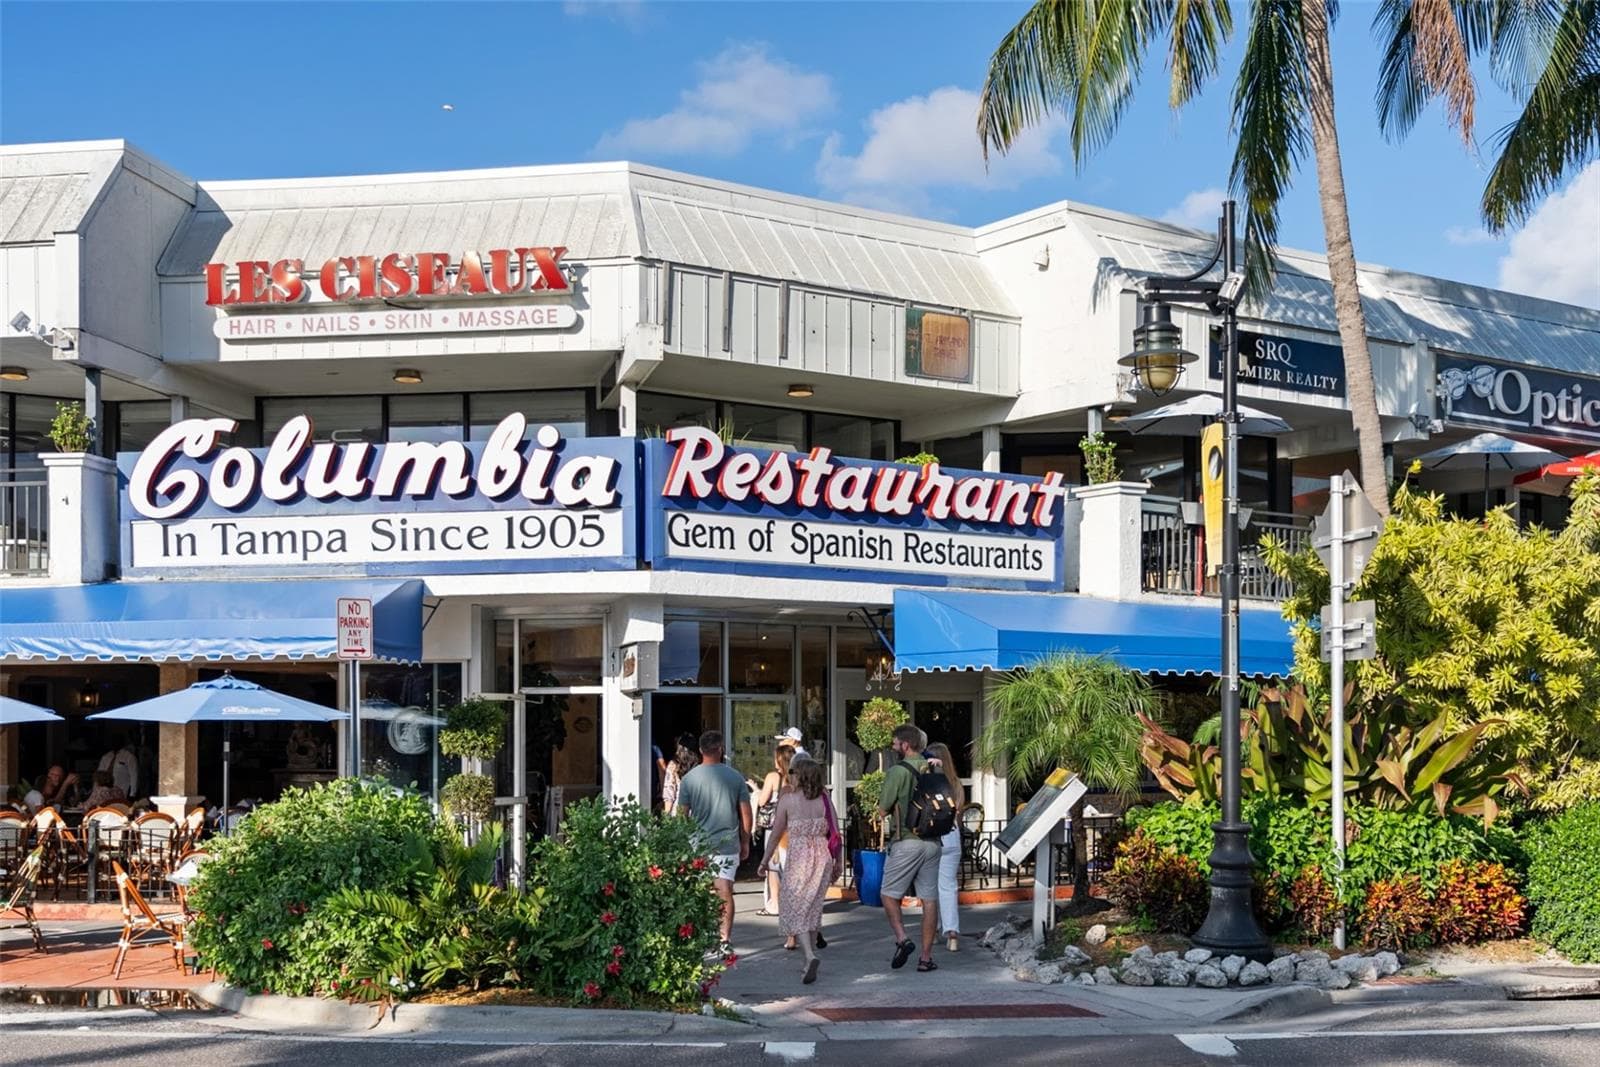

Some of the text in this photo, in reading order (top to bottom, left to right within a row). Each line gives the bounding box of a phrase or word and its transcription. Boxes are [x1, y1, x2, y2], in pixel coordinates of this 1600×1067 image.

[203, 246, 570, 307] LES CISEAUX
[229, 308, 559, 336] HAIR NAILS SKIN MASSAGE
[1255, 339, 1298, 369] SRQ
[1217, 360, 1338, 390] PMIER REALTY
[1493, 369, 1600, 428] Optic
[129, 411, 620, 519] Columbia
[661, 426, 1066, 527] Restaurant
[162, 514, 605, 561] In Tampa Since 1905
[667, 512, 1043, 571] Gem of Spanish Restaurants
[340, 616, 370, 629] PARKING
[347, 603, 361, 615] NO
[347, 637, 363, 647] TIME
[348, 629, 362, 637] ANY
